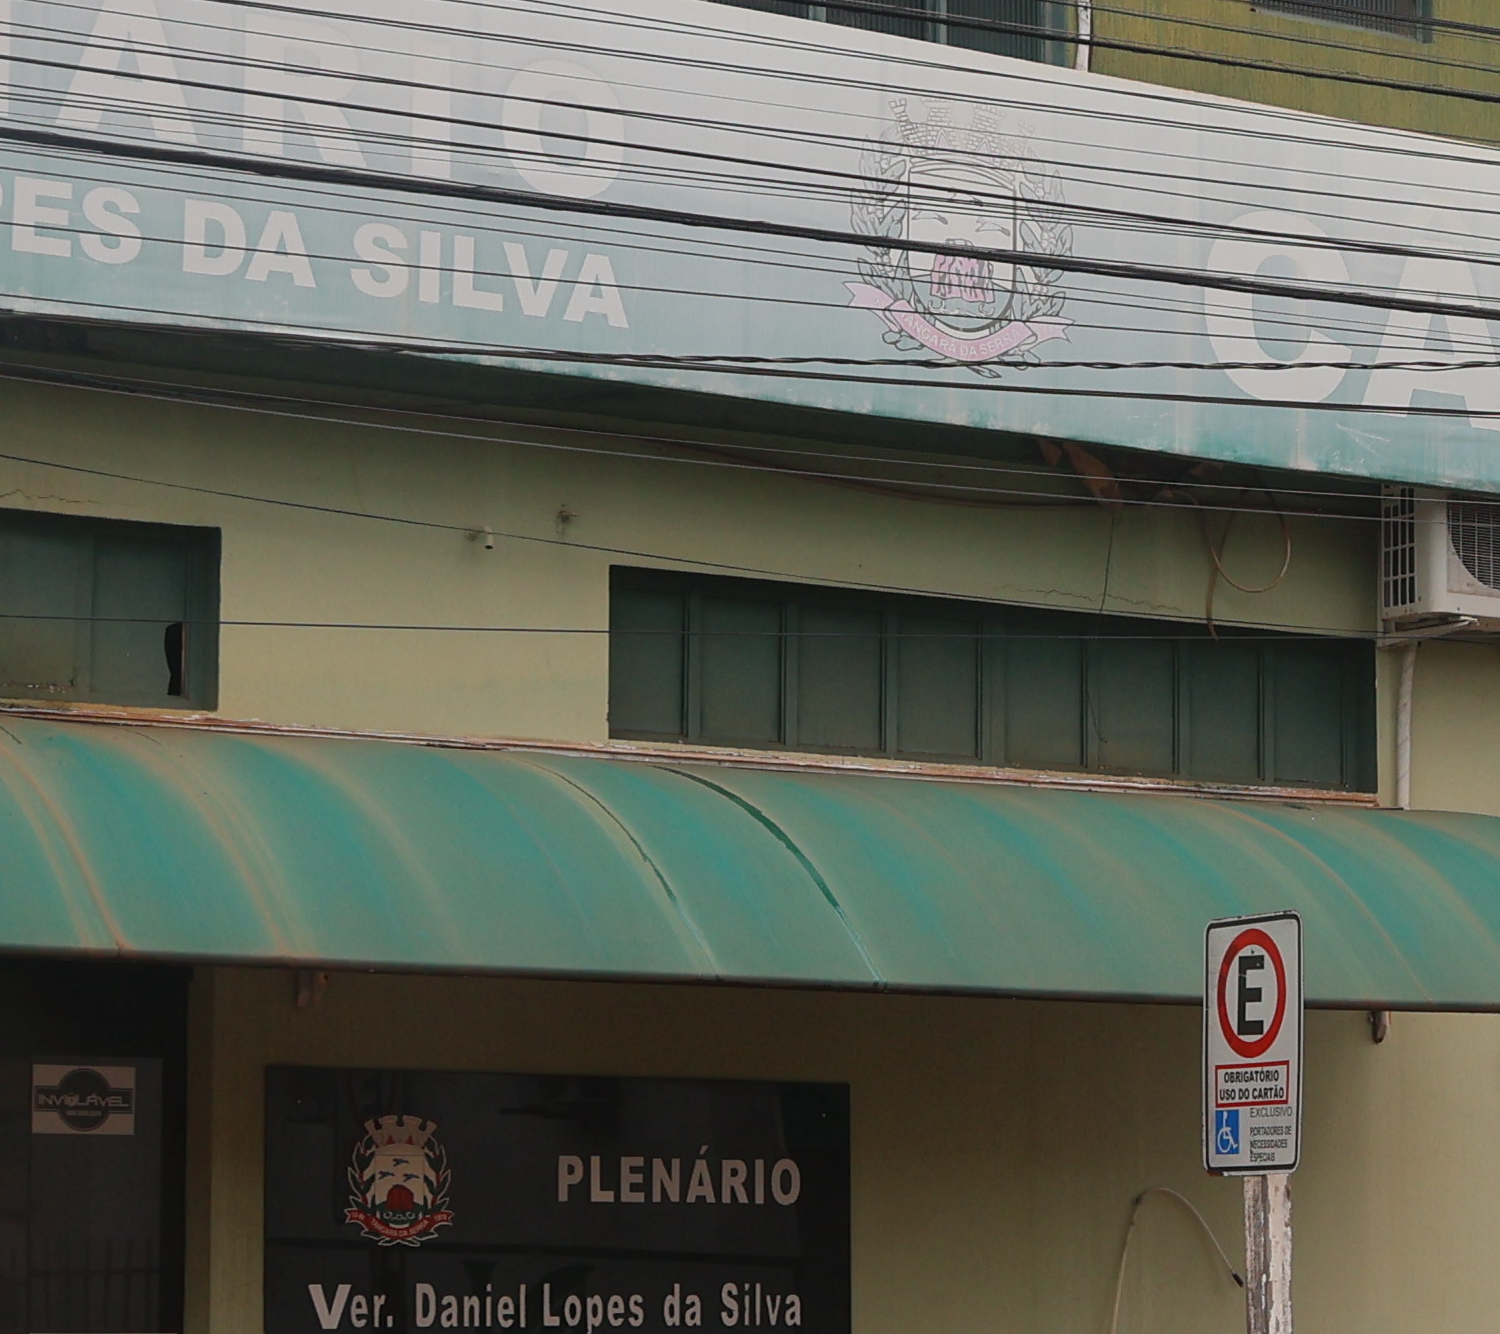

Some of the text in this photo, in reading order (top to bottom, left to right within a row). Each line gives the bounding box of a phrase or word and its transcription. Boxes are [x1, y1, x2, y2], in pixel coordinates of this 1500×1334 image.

[180, 206, 315, 290] DA
[350, 220, 631, 330] SILVA
[959, 345, 978, 358] DA
[1237, 954, 1265, 1036] E
[1219, 1083, 1285, 1101] USO DO CARTÃO
[1223, 1068, 1280, 1084] OBRIGATÓRIO
[1249, 1106, 1293, 1119] EXCLUSIVO
[556, 1145, 802, 1206] PLENÁRIO
[307, 1282, 394, 1331] Ver.
[414, 1282, 528, 1329] Daniel
[663, 1282, 703, 1329] da
[720, 1281, 802, 1329] Silva
